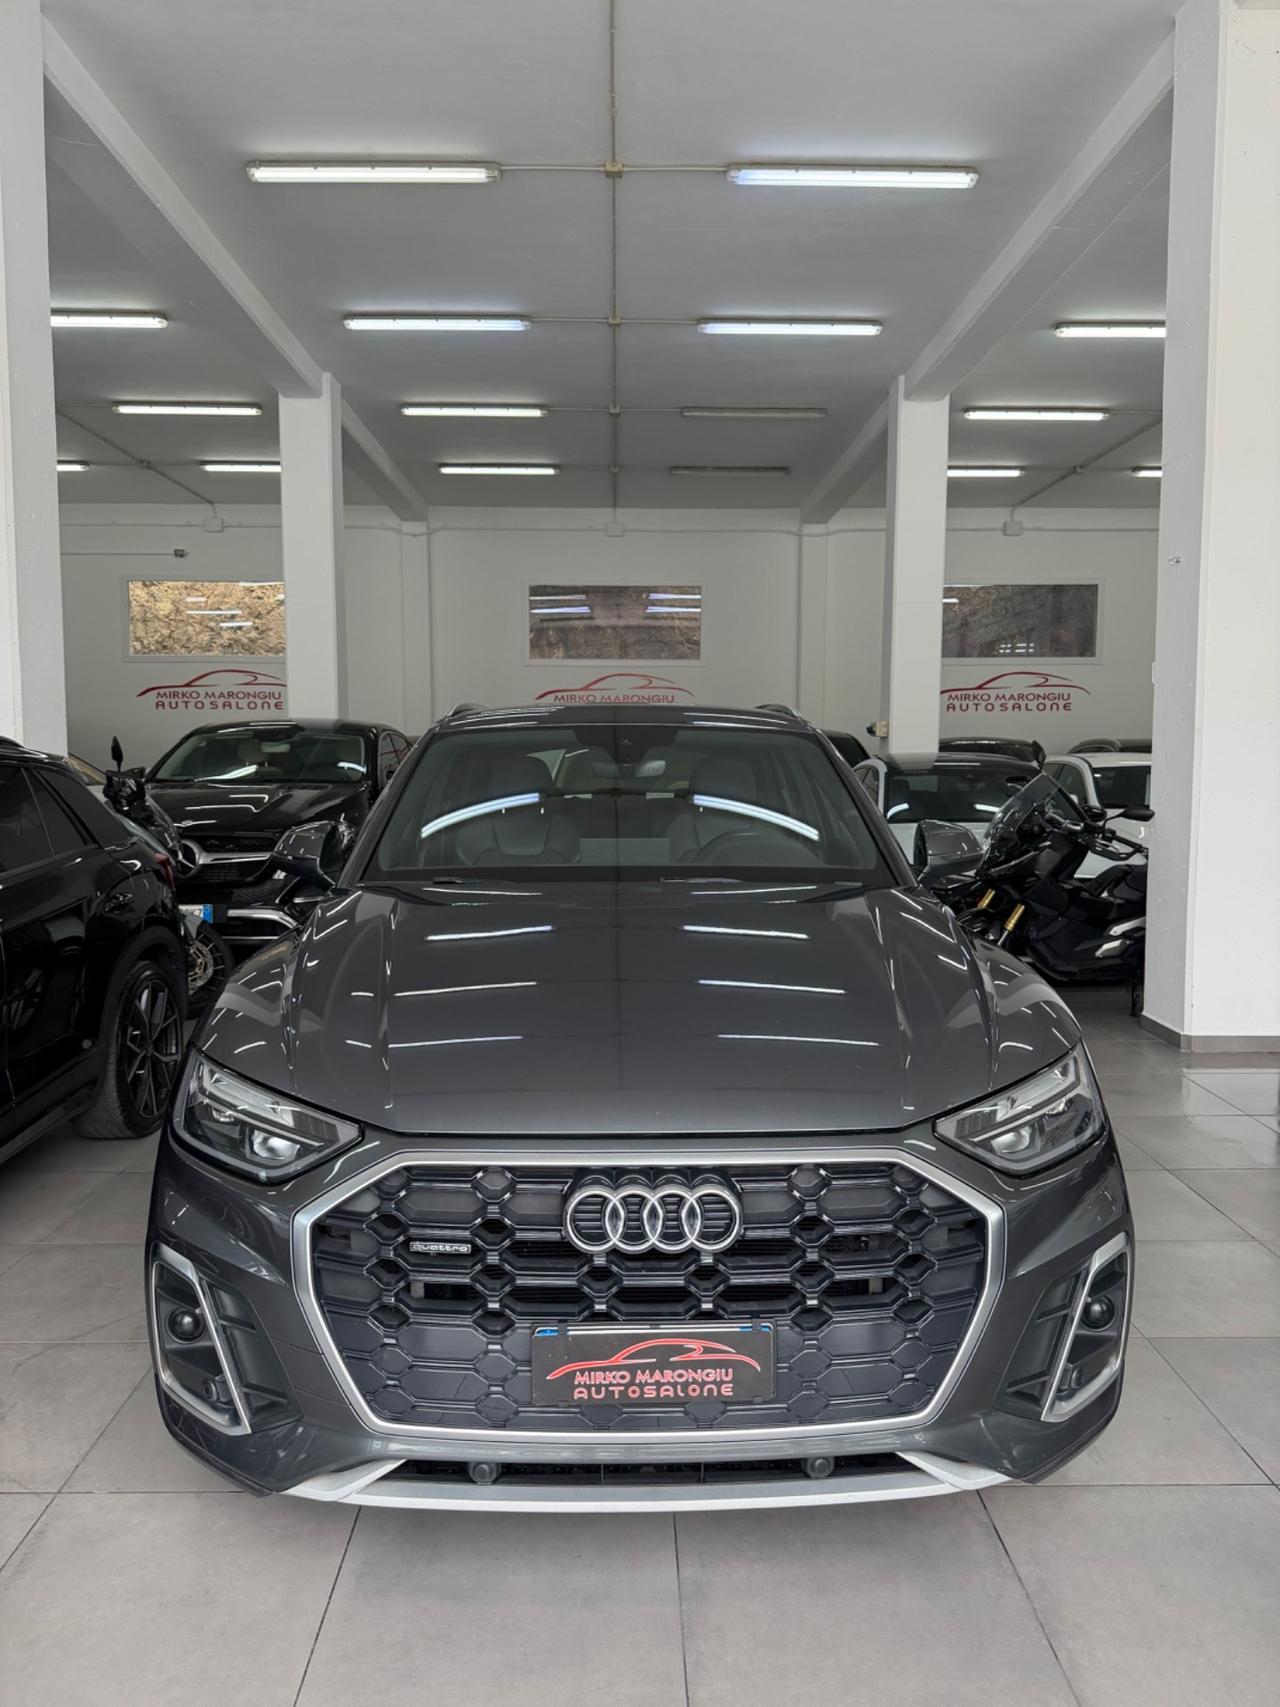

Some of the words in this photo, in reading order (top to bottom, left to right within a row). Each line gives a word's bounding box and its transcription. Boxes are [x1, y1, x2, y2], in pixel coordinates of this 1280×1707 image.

[156, 691, 200, 700] MIRKO
[204, 691, 282, 700] MARONGIU
[553, 694, 597, 703] MIRKO
[600, 694, 675, 703] MARONGIU
[947, 692, 991, 701] MIRKO
[994, 692, 1071, 701] MARONGIU
[155, 701, 284, 710] AUTOSALONE
[946, 702, 1072, 712] AUTOSALONE
[411, 1243, 469, 1253] quattro
[574, 1370, 631, 1385] MIRKO
[635, 1368, 734, 1383] MARONGIU
[573, 1383, 734, 1399] AUTOSALONE
